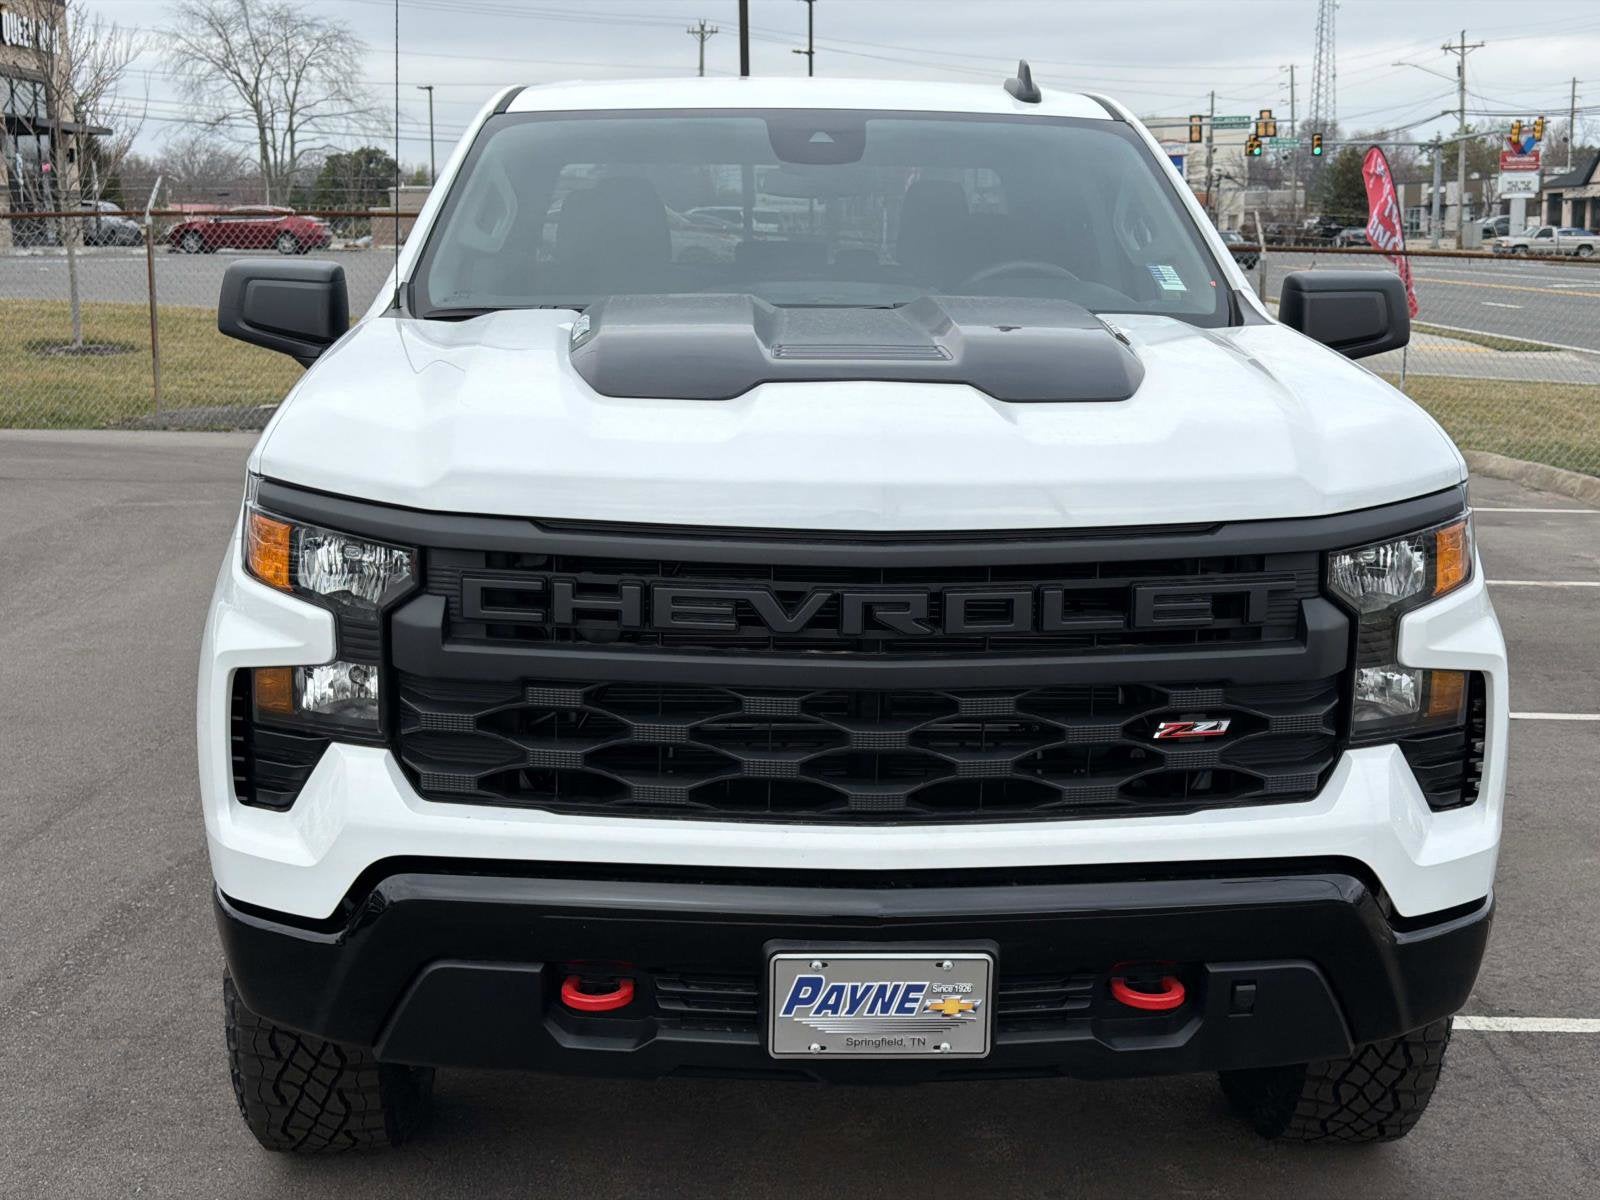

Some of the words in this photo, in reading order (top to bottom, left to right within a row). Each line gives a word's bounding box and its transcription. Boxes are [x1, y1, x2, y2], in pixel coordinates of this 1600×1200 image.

[461, 574, 1296, 634] CHEVROLET
[1153, 720, 1231, 739] Z71
[932, 983, 954, 993] Since
[846, 1037, 906, 1048] Springfield,
[909, 1037, 926, 1047] TN
